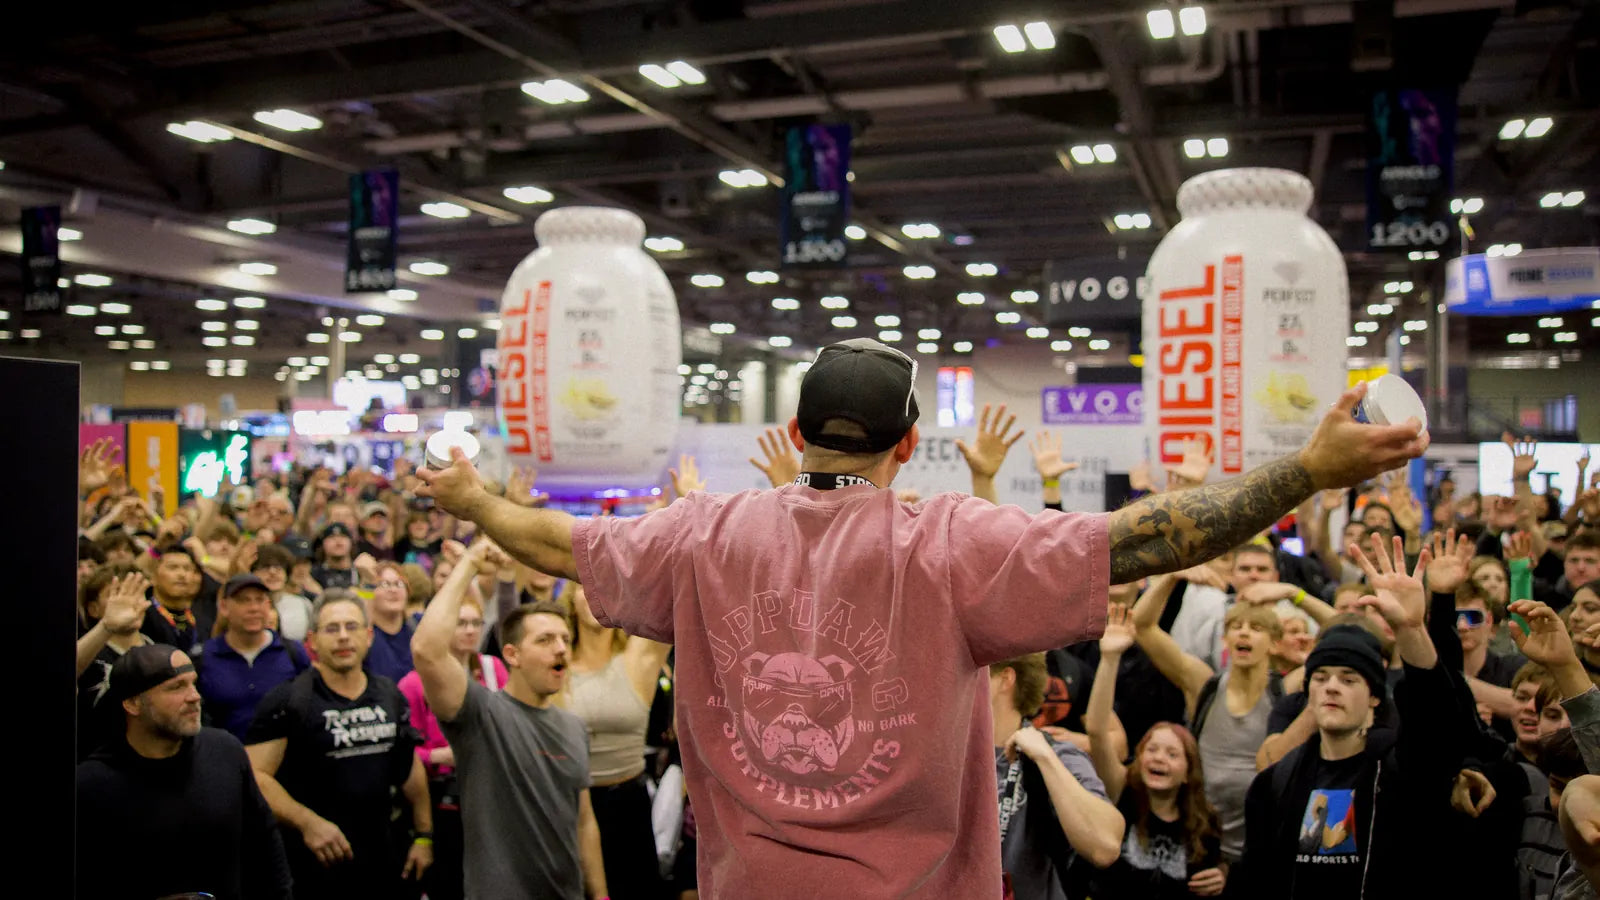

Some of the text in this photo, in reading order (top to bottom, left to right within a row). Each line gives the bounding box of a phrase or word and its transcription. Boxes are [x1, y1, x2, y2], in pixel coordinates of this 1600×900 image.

[1369, 221, 1449, 247] 1200
[498, 288, 533, 456] DIESEL
[1159, 264, 1216, 464] DIESEL
[857, 712, 918, 733] NO BARK
[723, 722, 901, 811] SUPPLEMENTS
[1312, 854, 1348, 864] SPORTS
